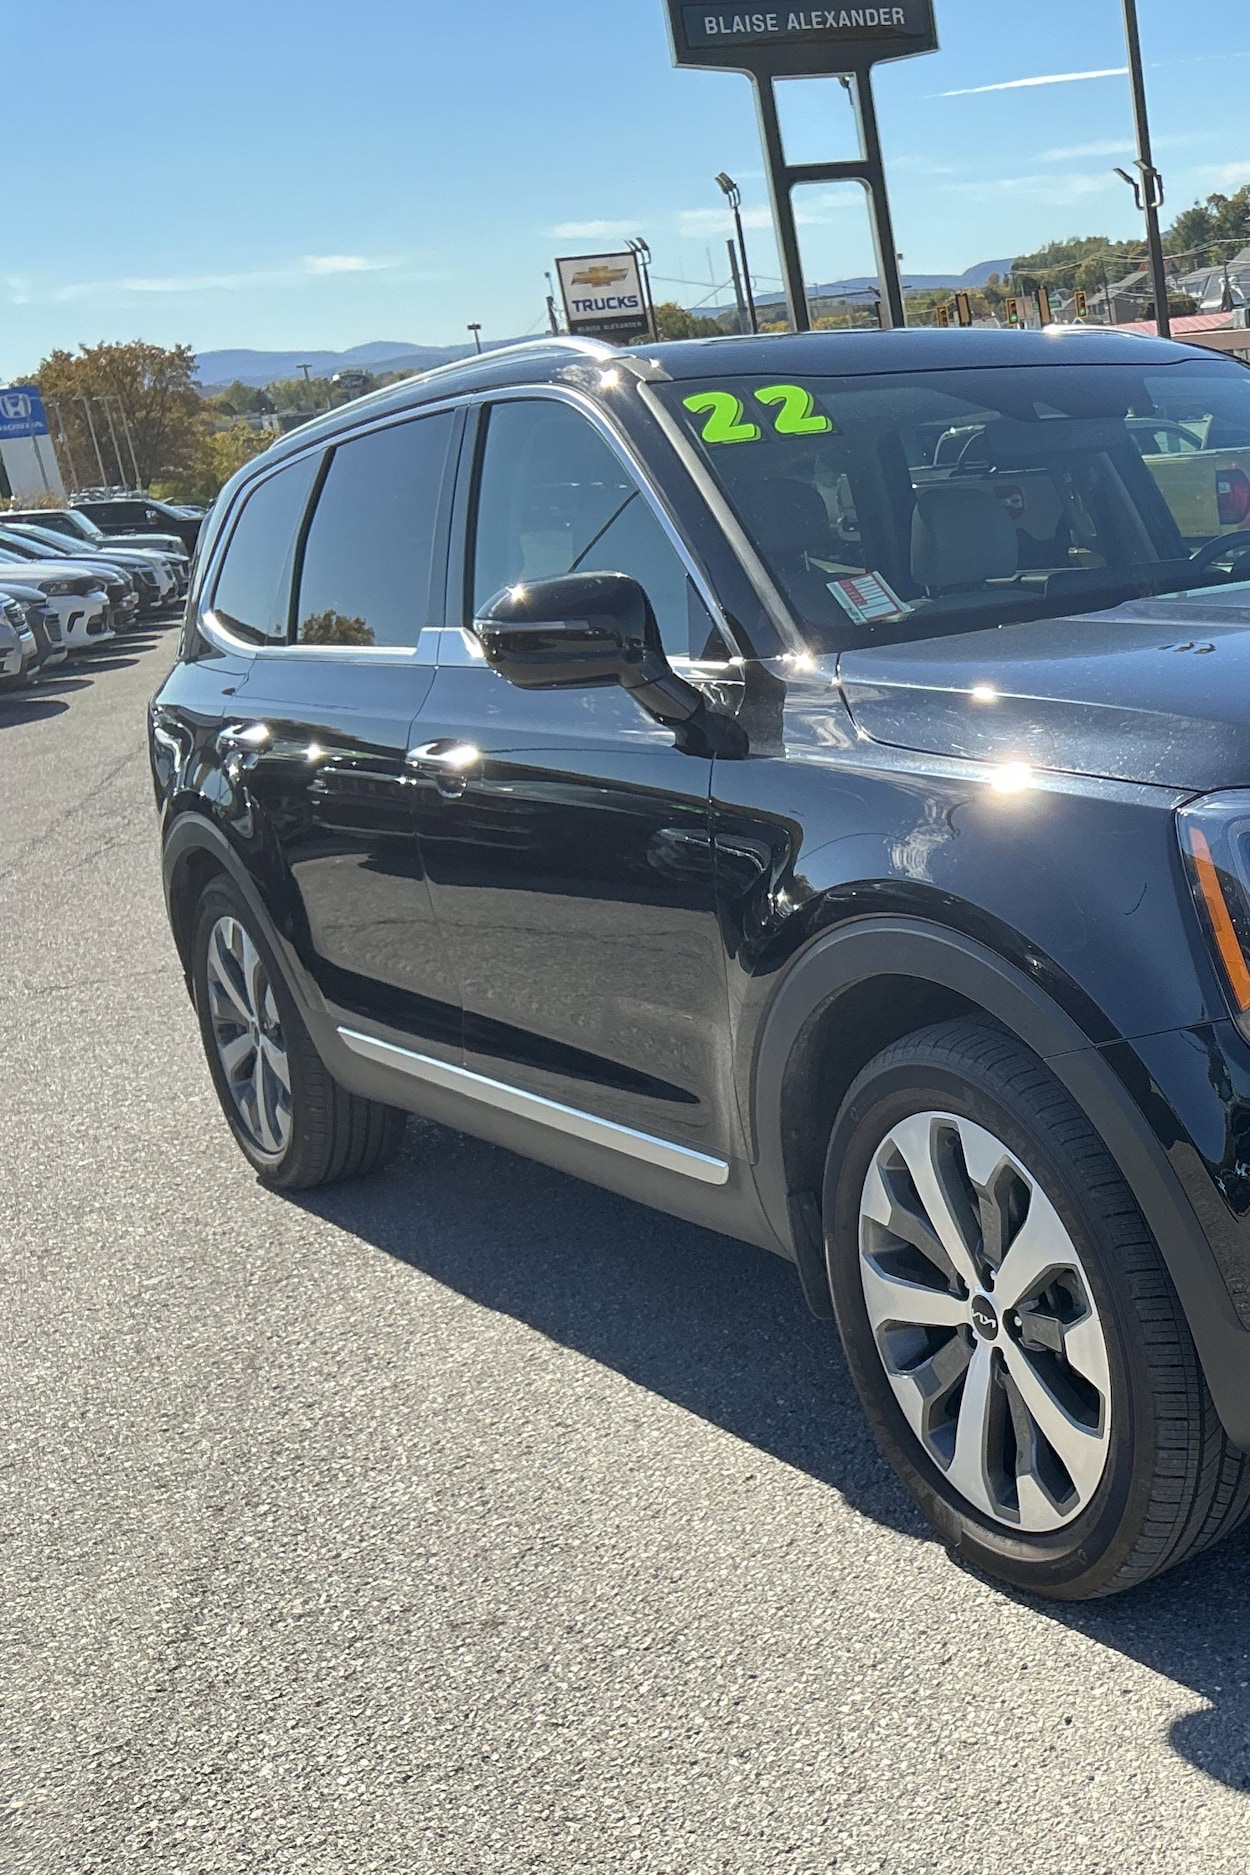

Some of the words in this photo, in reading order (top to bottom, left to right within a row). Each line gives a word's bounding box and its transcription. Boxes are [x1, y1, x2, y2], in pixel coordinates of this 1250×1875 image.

[704, 14, 779, 35] BLAISE
[787, 7, 905, 30] ALEXANDER
[571, 296, 638, 312] TRUCKS
[682, 384, 833, 444] 22
